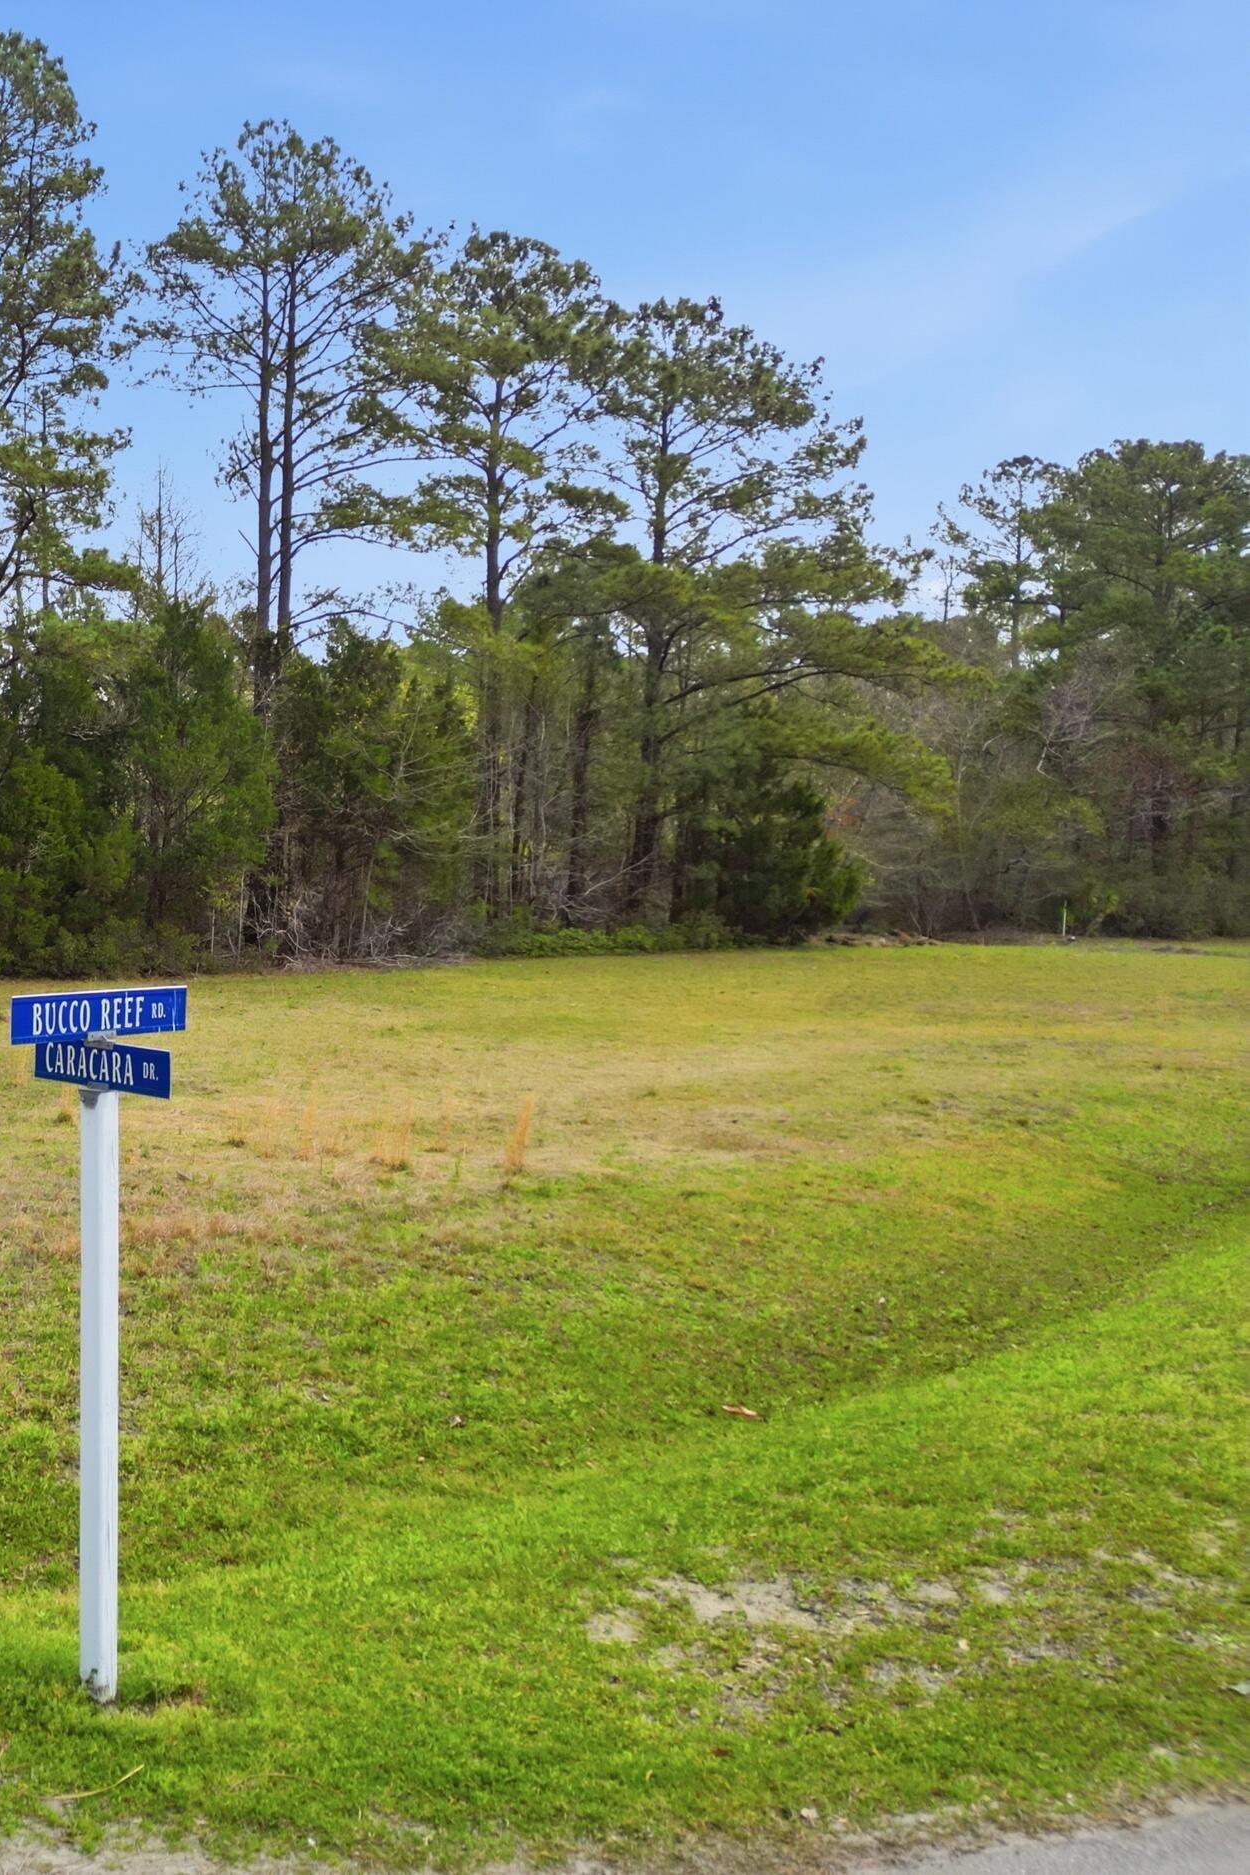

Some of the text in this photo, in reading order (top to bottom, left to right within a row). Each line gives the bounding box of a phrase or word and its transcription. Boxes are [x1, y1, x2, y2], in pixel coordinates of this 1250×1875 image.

[32, 996, 166, 1036] BUCCO REEF RD.
[45, 1042, 159, 1086] CARACARA DR.
